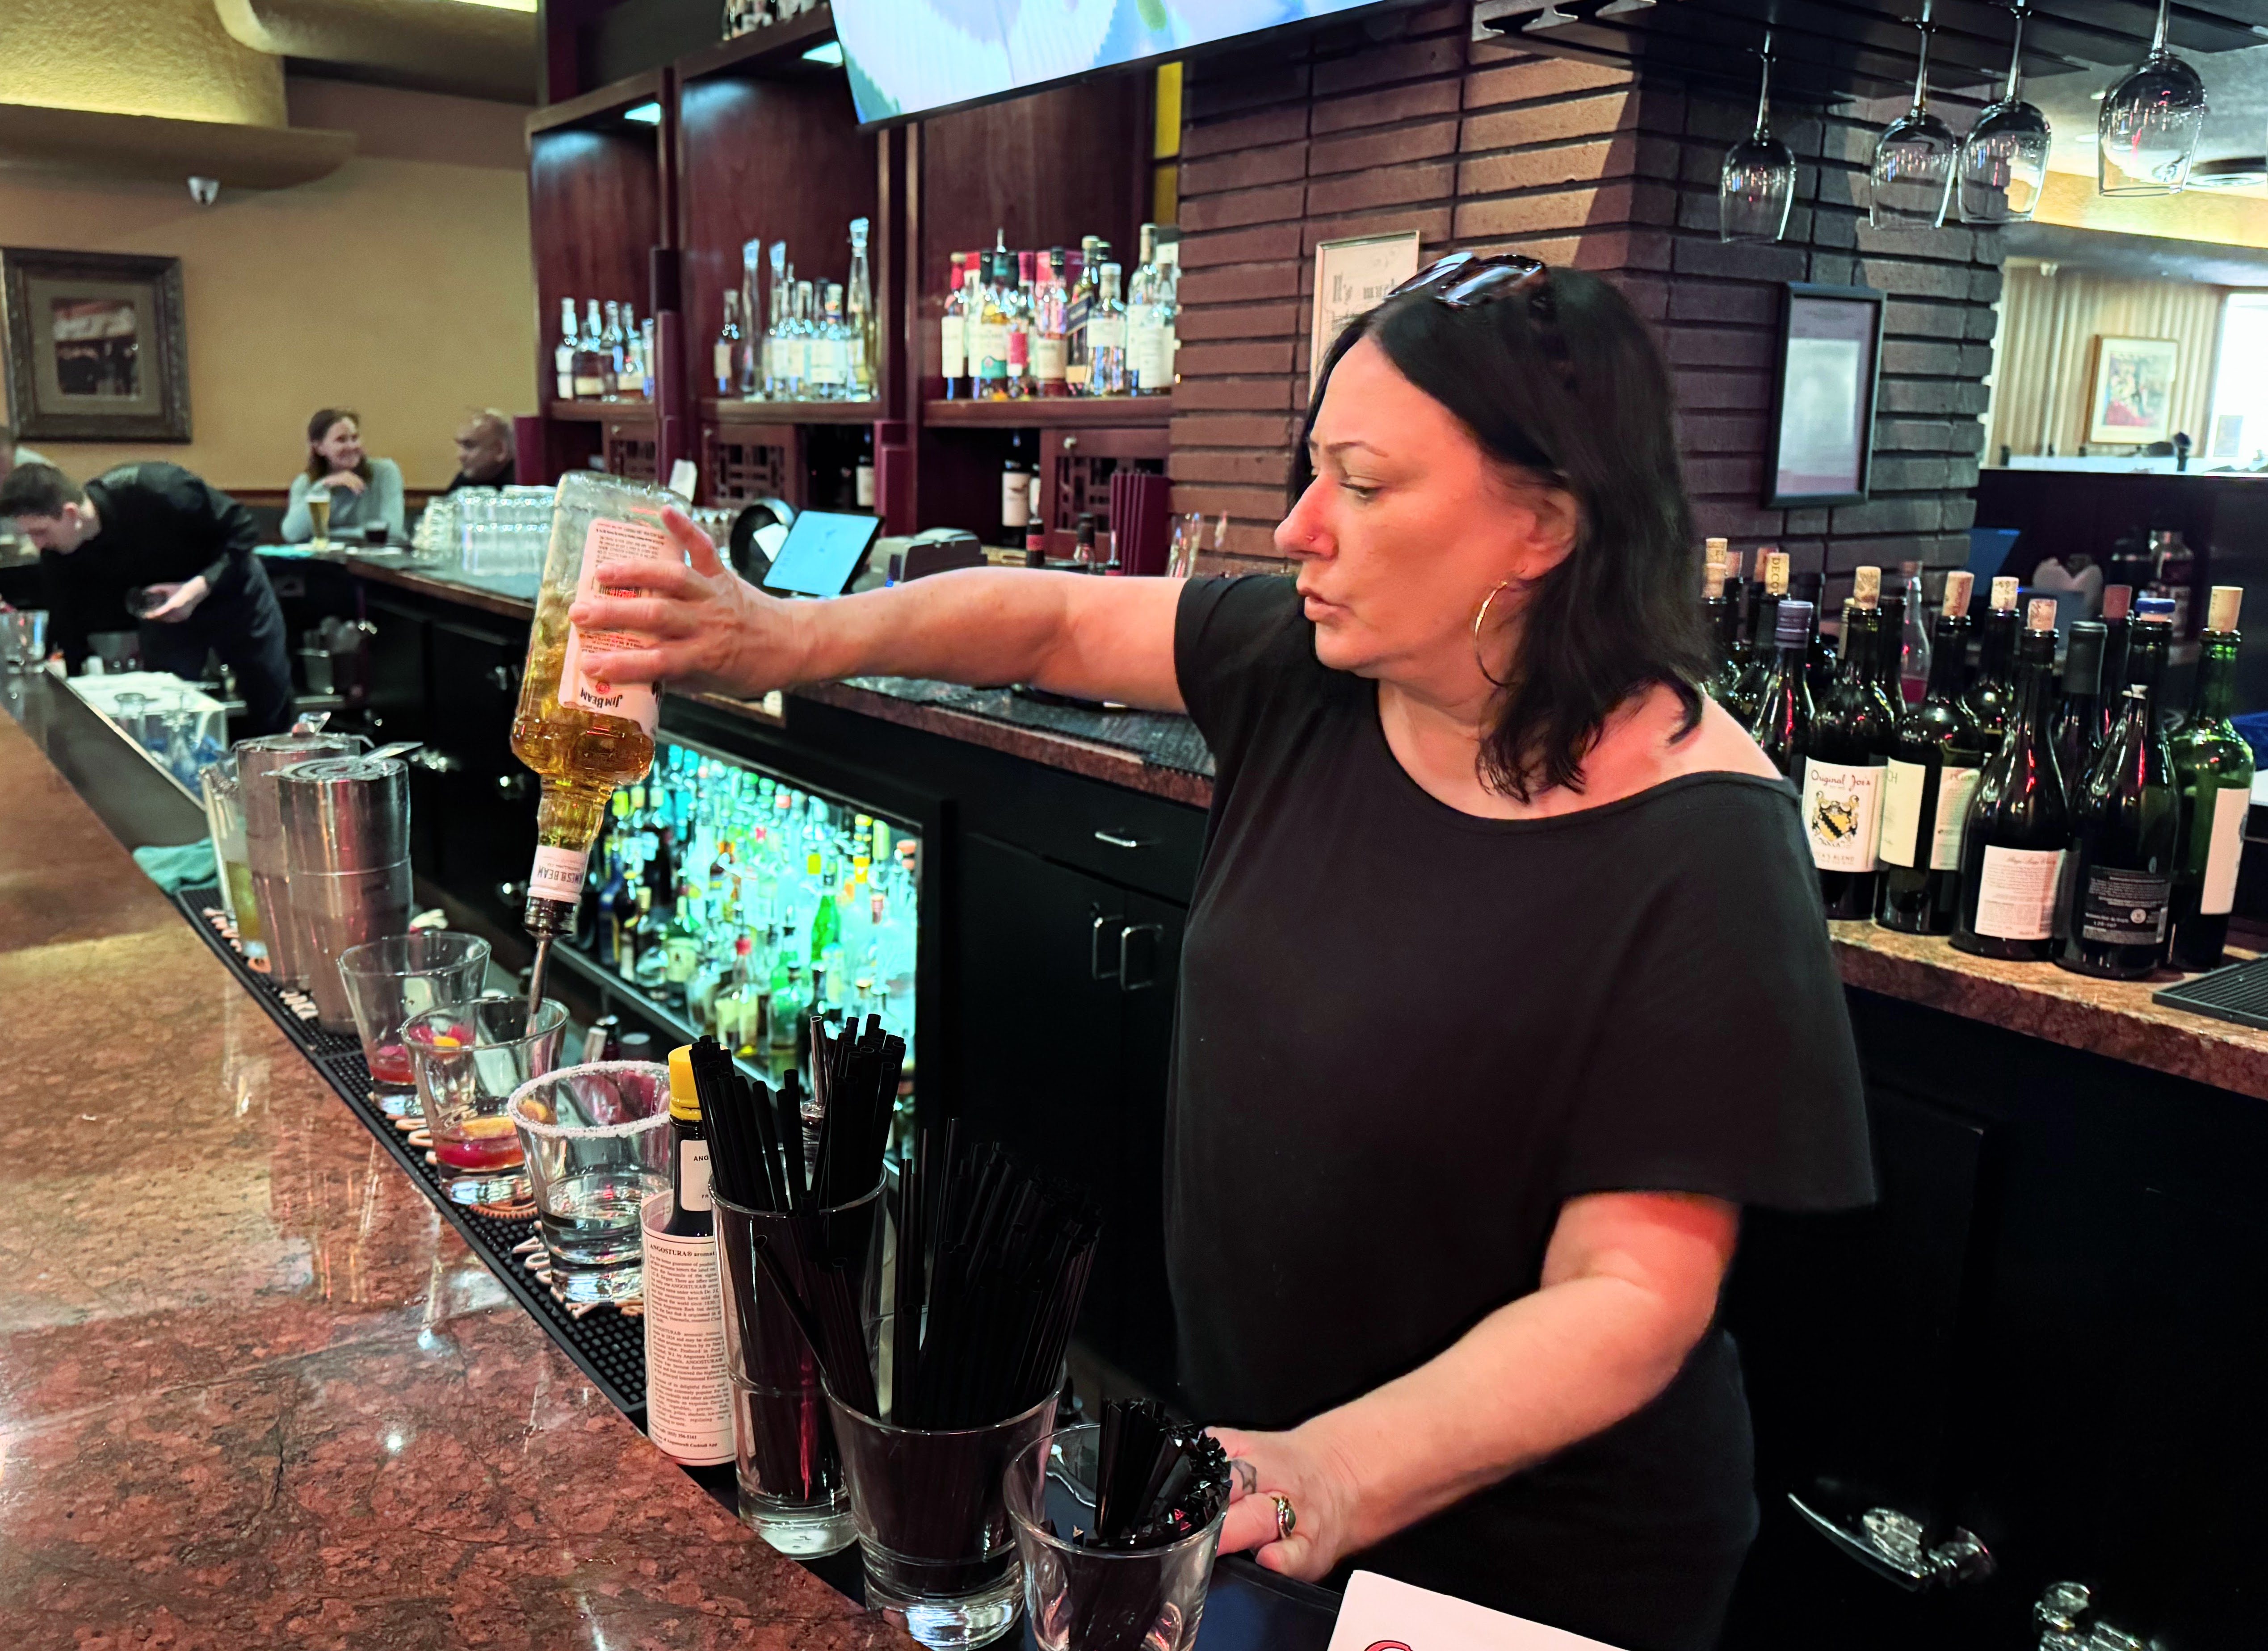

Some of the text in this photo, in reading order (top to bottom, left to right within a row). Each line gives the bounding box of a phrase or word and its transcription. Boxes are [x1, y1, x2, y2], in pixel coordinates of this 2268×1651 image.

[580, 687, 623, 708] JIM BEAM
[1810, 769, 1845, 786] Original
[537, 864, 559, 881] BEAM
